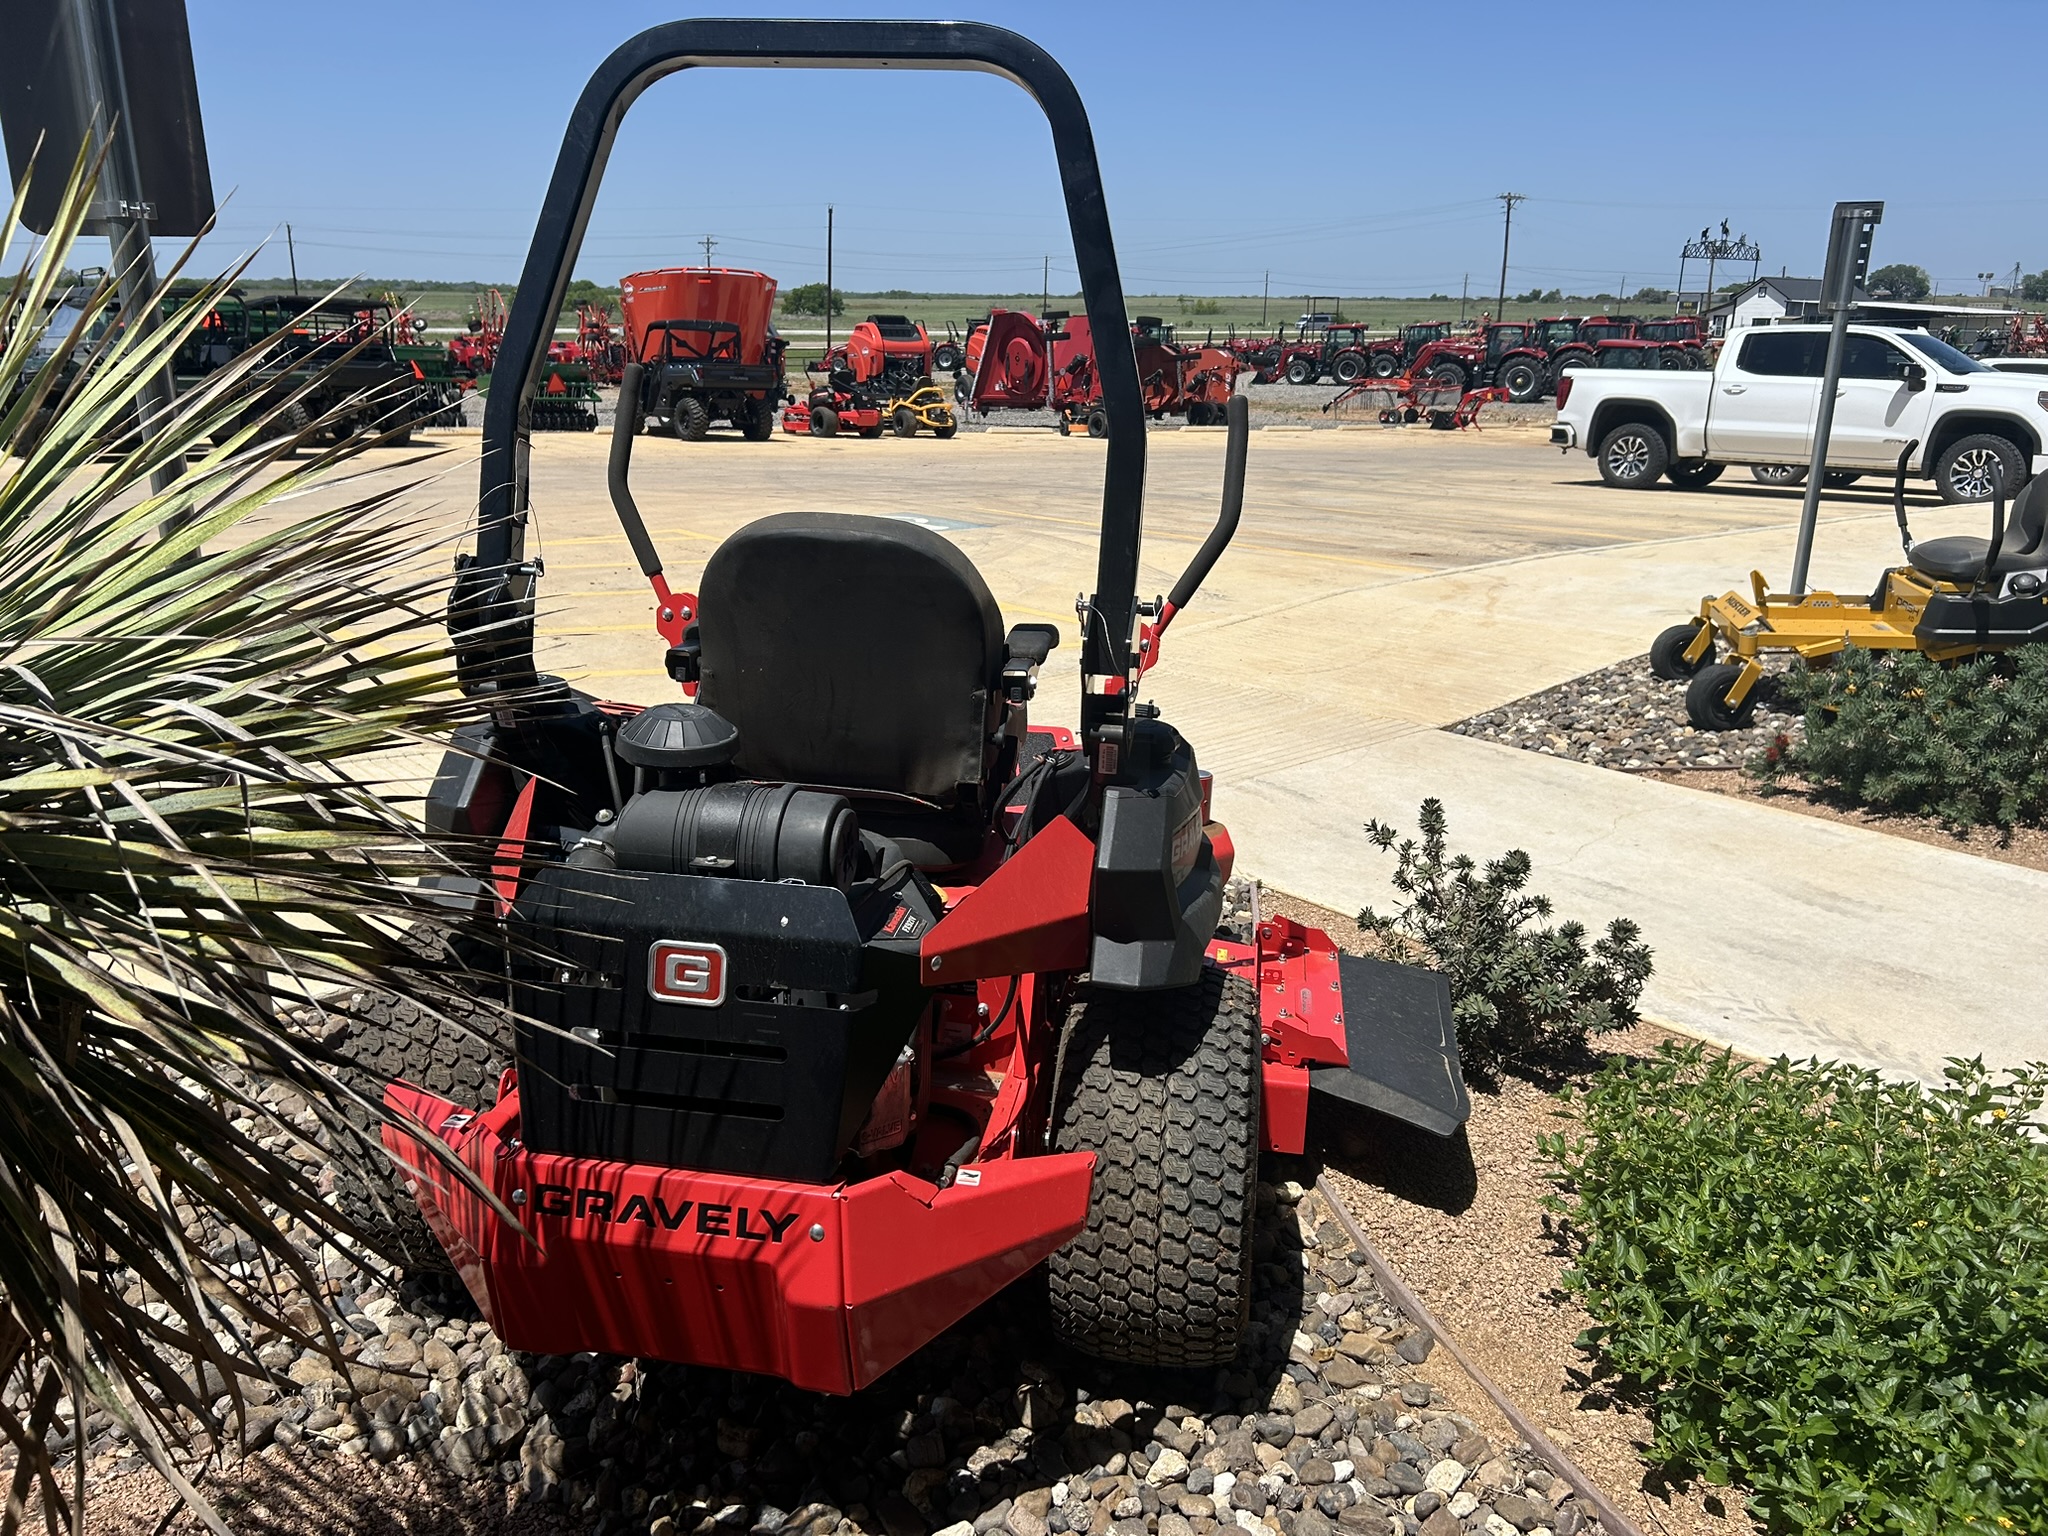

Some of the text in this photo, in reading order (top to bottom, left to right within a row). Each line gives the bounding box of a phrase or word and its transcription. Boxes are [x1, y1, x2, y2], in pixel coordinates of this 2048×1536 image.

[1726, 595, 1751, 617] HUSTLER
[883, 906, 907, 934] Kawasaki
[665, 953, 710, 993] G
[533, 1184, 799, 1243] GRAVELY
